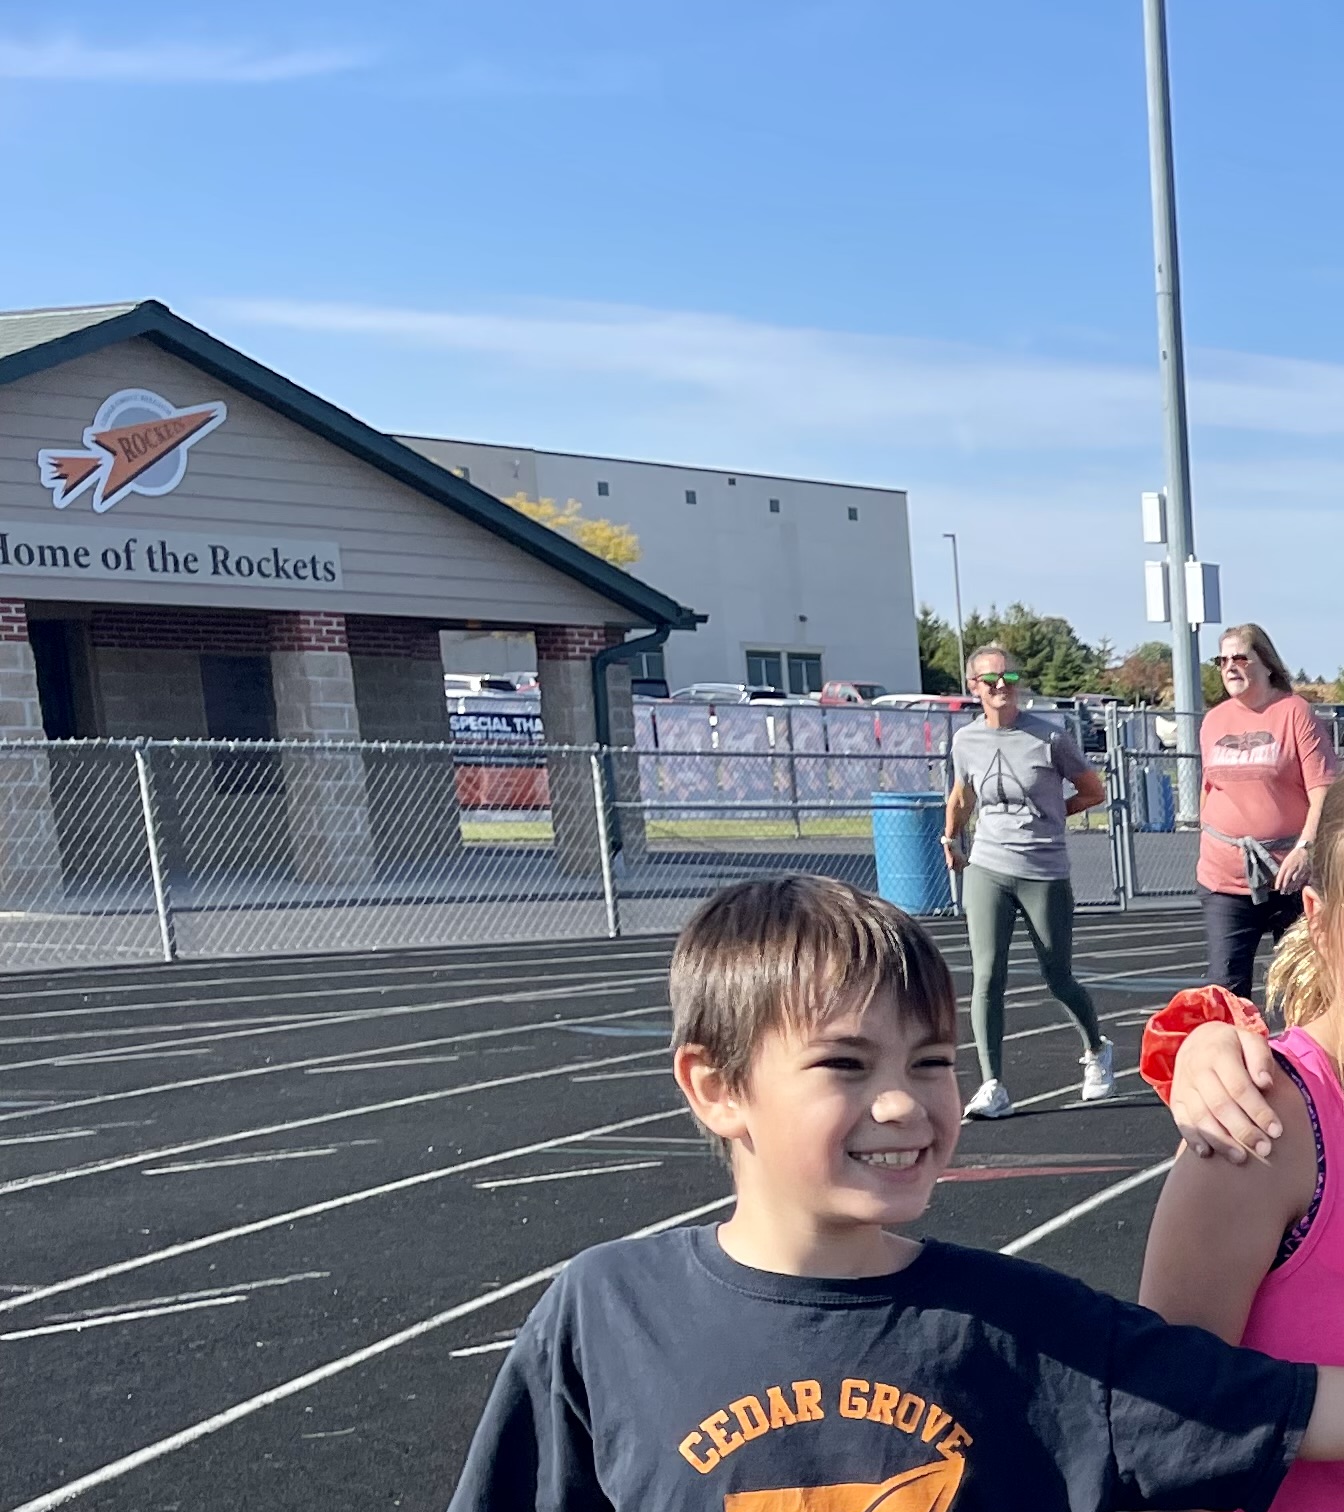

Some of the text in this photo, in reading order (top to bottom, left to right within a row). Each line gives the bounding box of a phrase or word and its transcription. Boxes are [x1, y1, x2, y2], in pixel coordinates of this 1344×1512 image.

[101, 538, 137, 571] of
[148, 540, 199, 575] the
[207, 543, 336, 583] Rockets
[449, 715, 512, 731] SPECIAL
[678, 1377, 974, 1474] CEDAR GROVE
